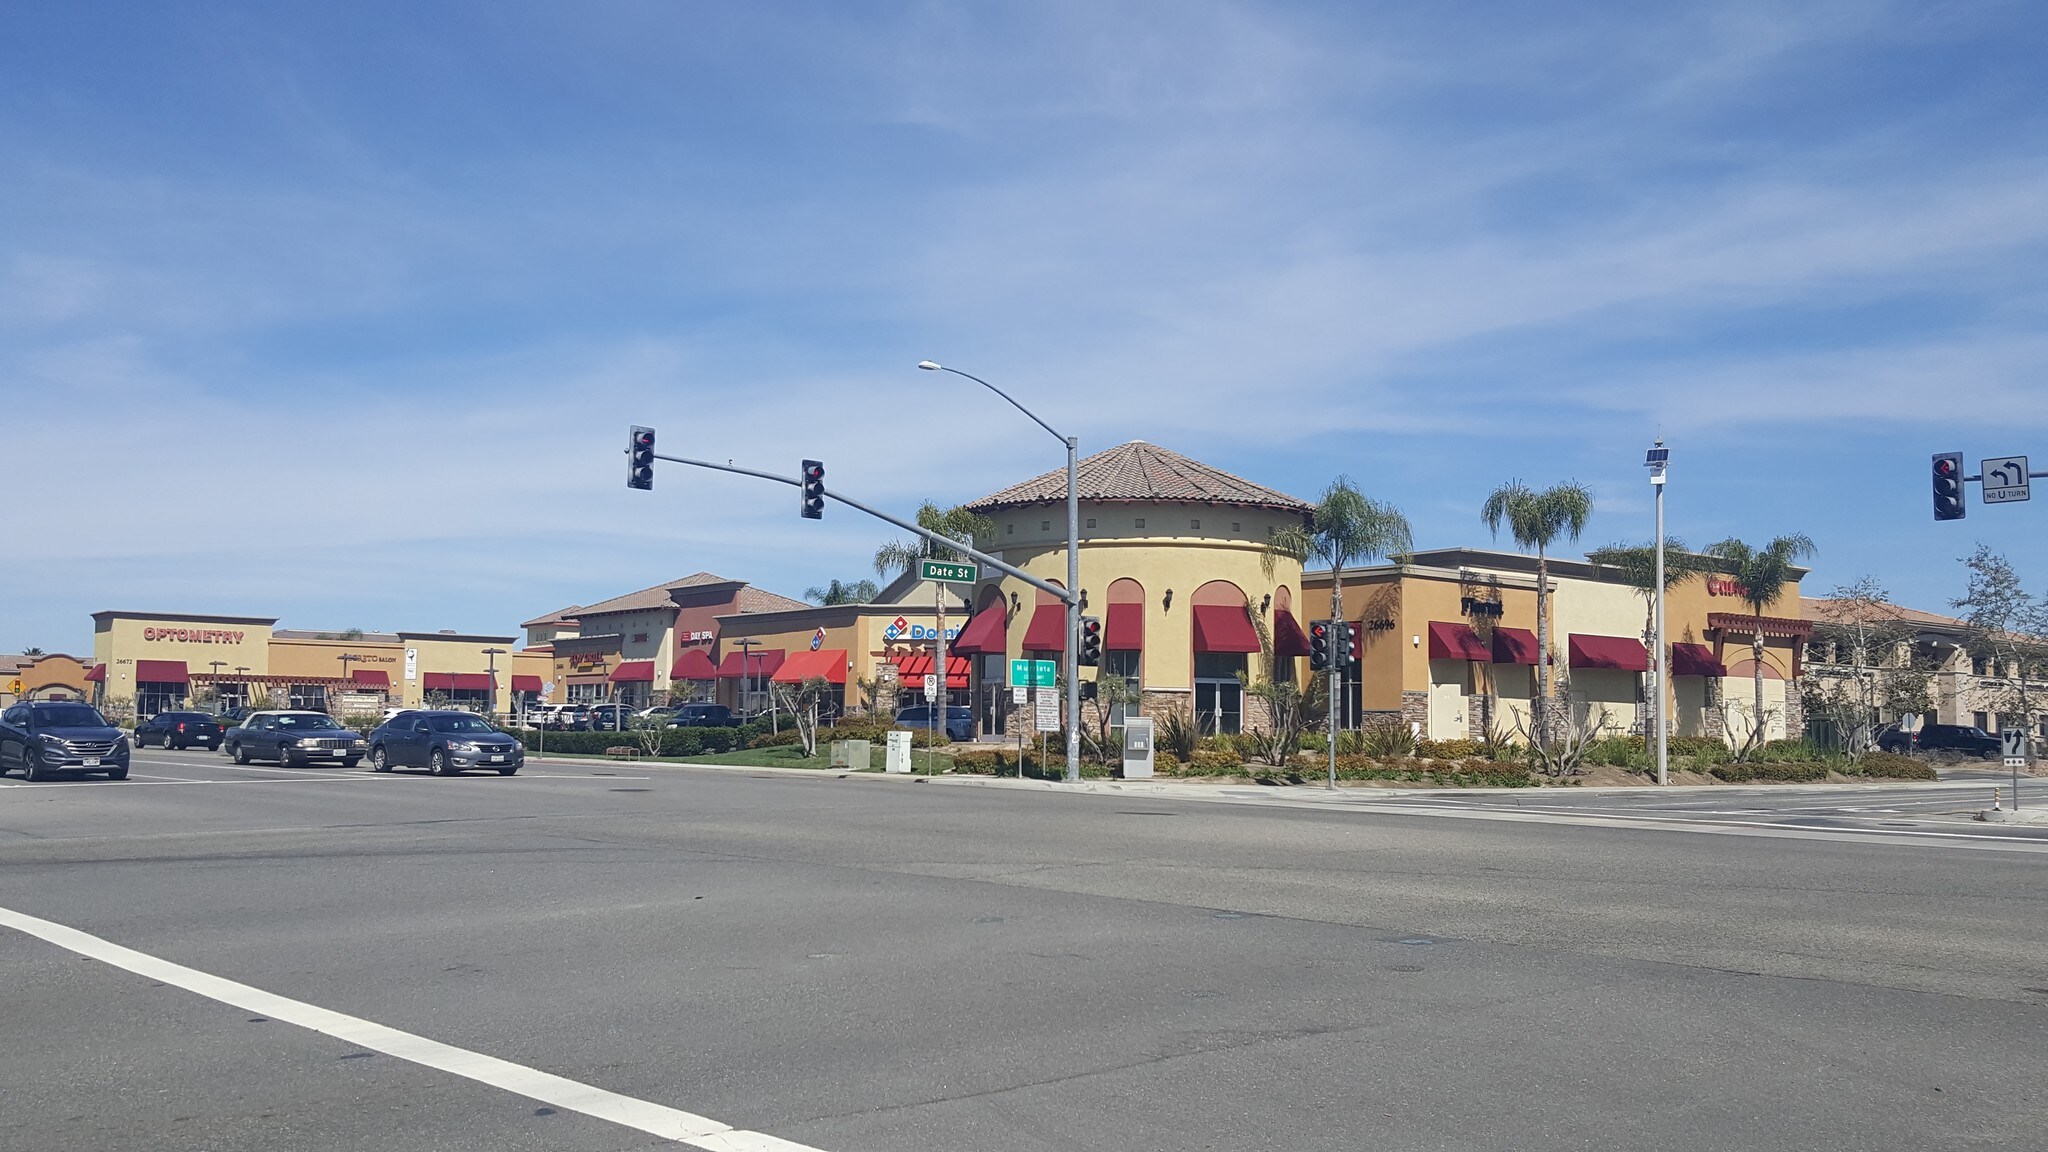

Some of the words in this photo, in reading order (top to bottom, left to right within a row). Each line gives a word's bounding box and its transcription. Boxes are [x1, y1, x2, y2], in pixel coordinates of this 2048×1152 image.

[1997, 490, 2006, 499] U
[929, 565, 953, 577] Date
[957, 568, 968, 578] St
[1368, 619, 1395, 630] 26696
[144, 627, 244, 644] OPTOMETRY
[690, 631, 701, 640] DAY
[701, 630, 713, 640] SPA
